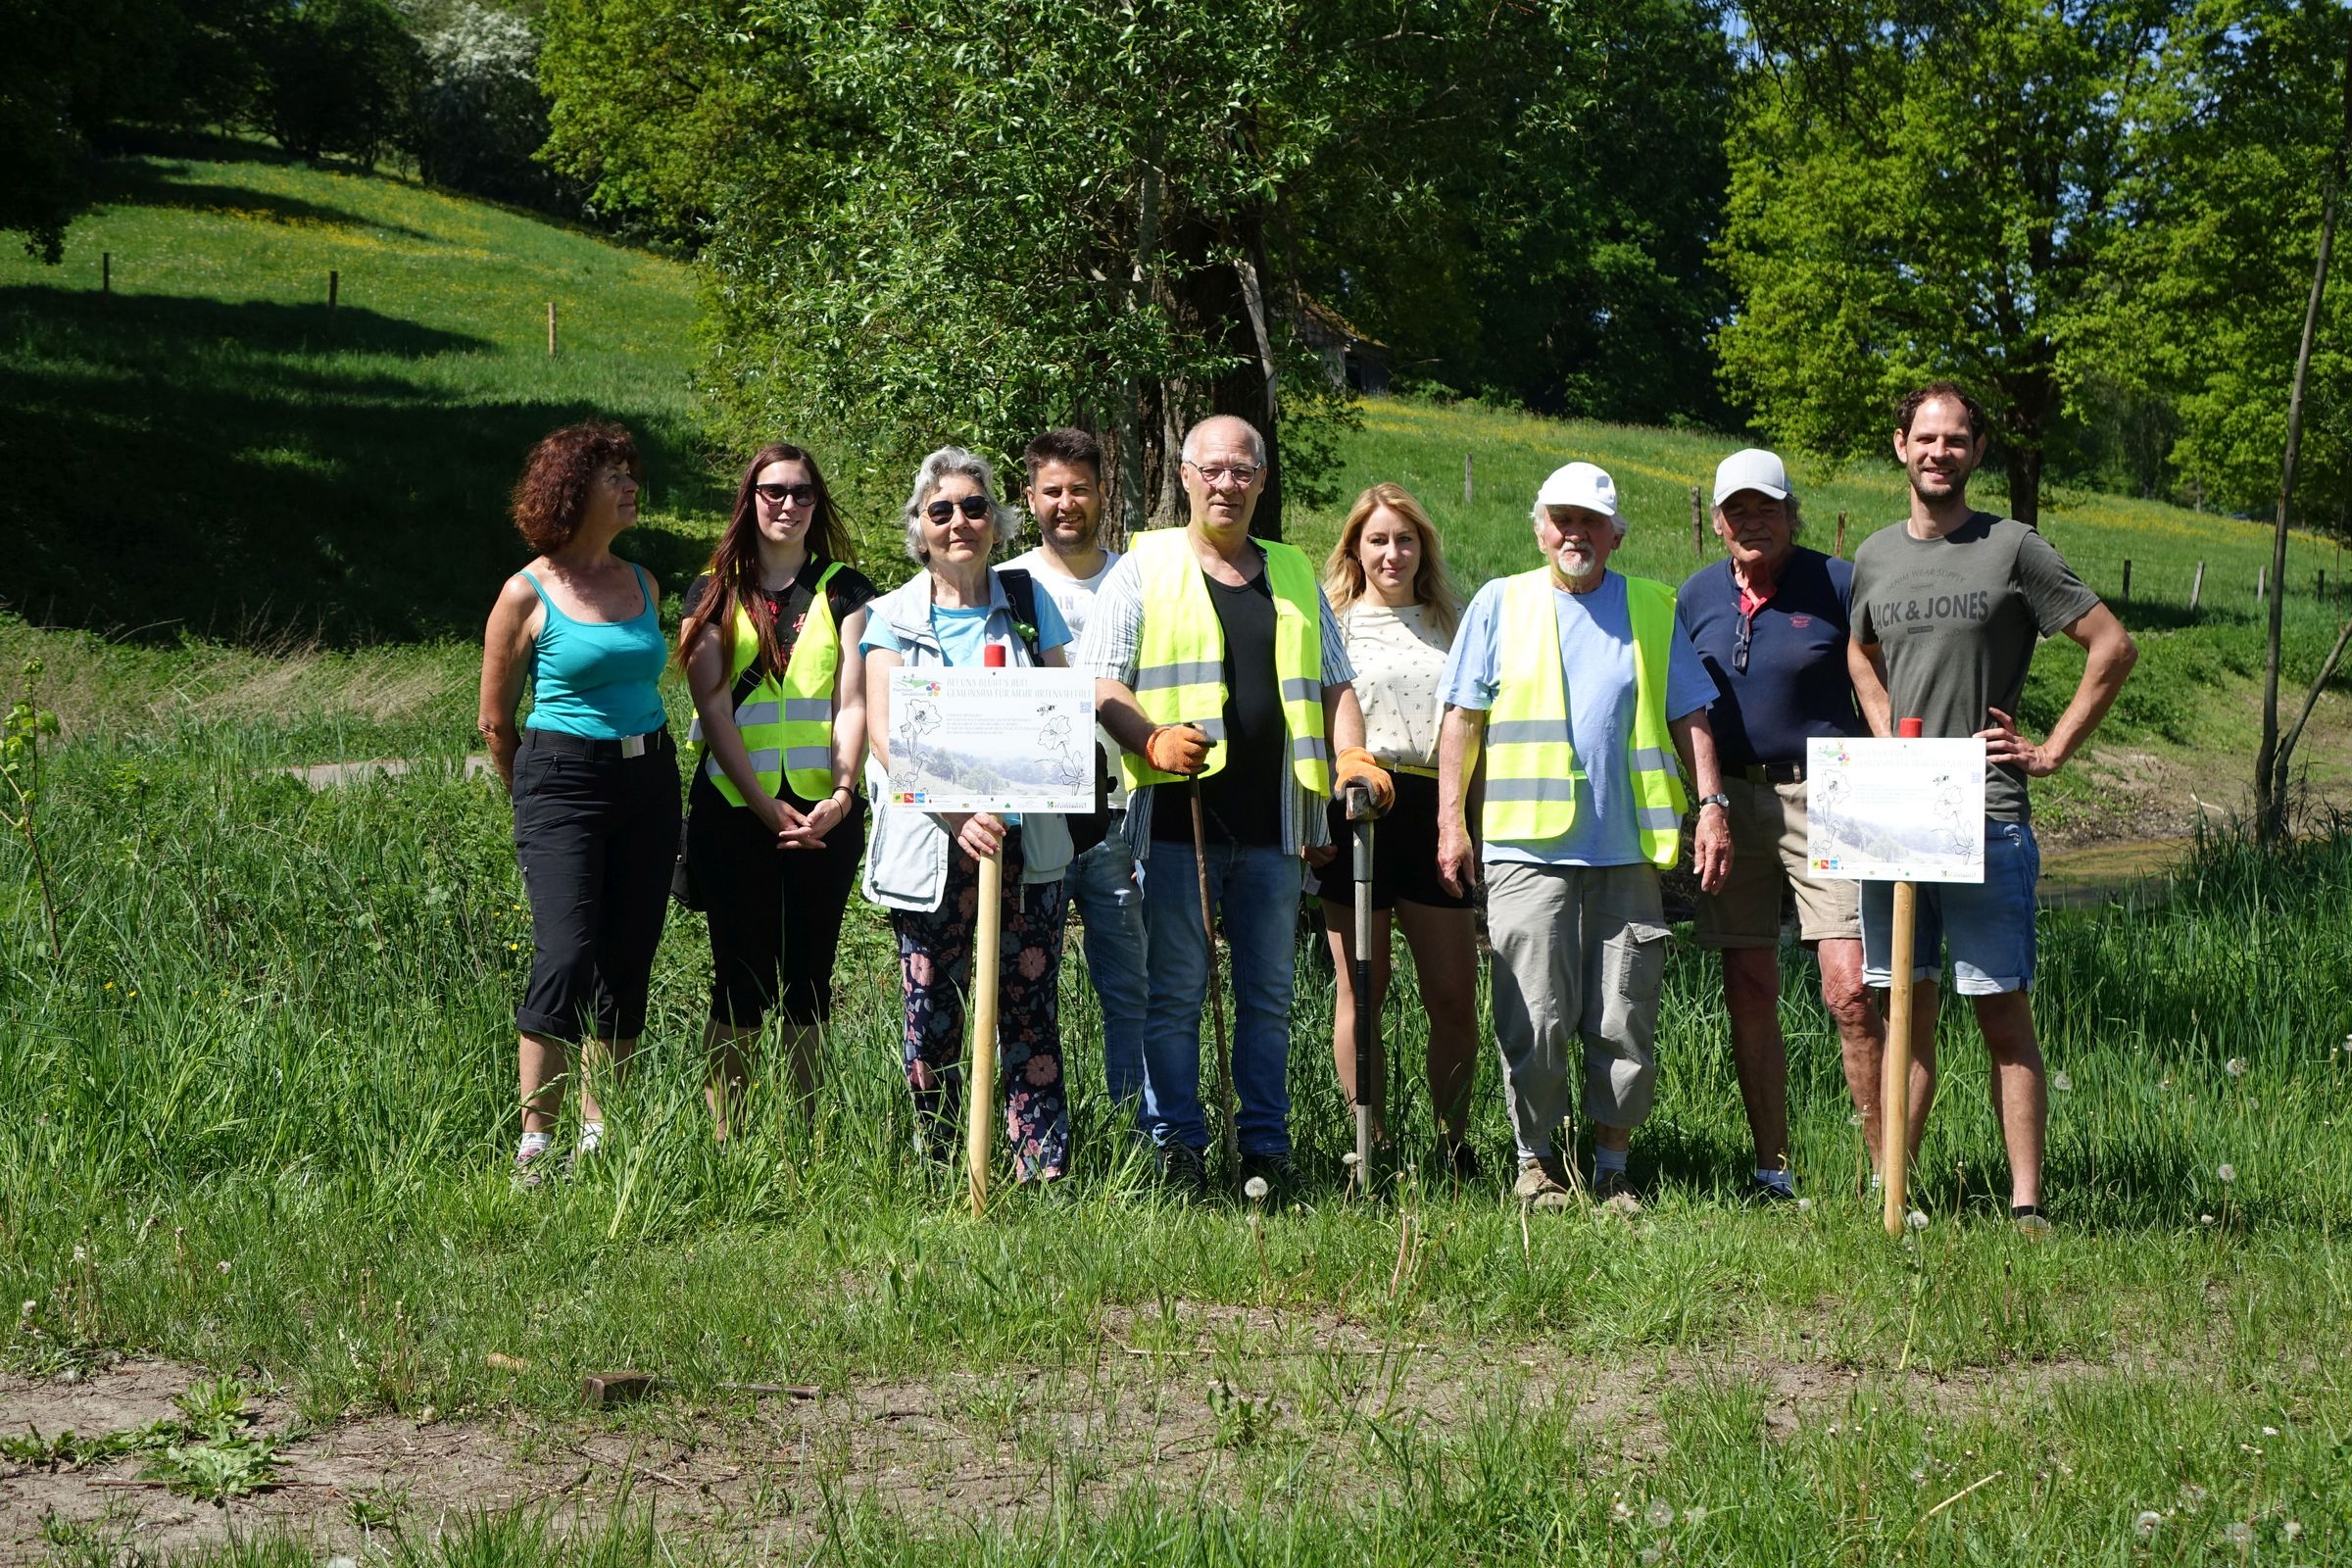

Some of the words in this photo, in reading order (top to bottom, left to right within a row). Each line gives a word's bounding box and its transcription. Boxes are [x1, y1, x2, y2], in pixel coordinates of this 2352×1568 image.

[1912, 567, 1936, 578] WEAR
[1936, 568, 1967, 583] SUPPLY
[1873, 600, 1902, 632] JACK
[1905, 600, 1921, 621] &
[1924, 590, 1989, 622] JONES
[947, 689, 993, 699] GEMEINSAM
[995, 687, 1009, 699] FÜR
[1011, 689, 1033, 699] MEHR
[1034, 689, 1092, 699] ARTENVIELFALT
